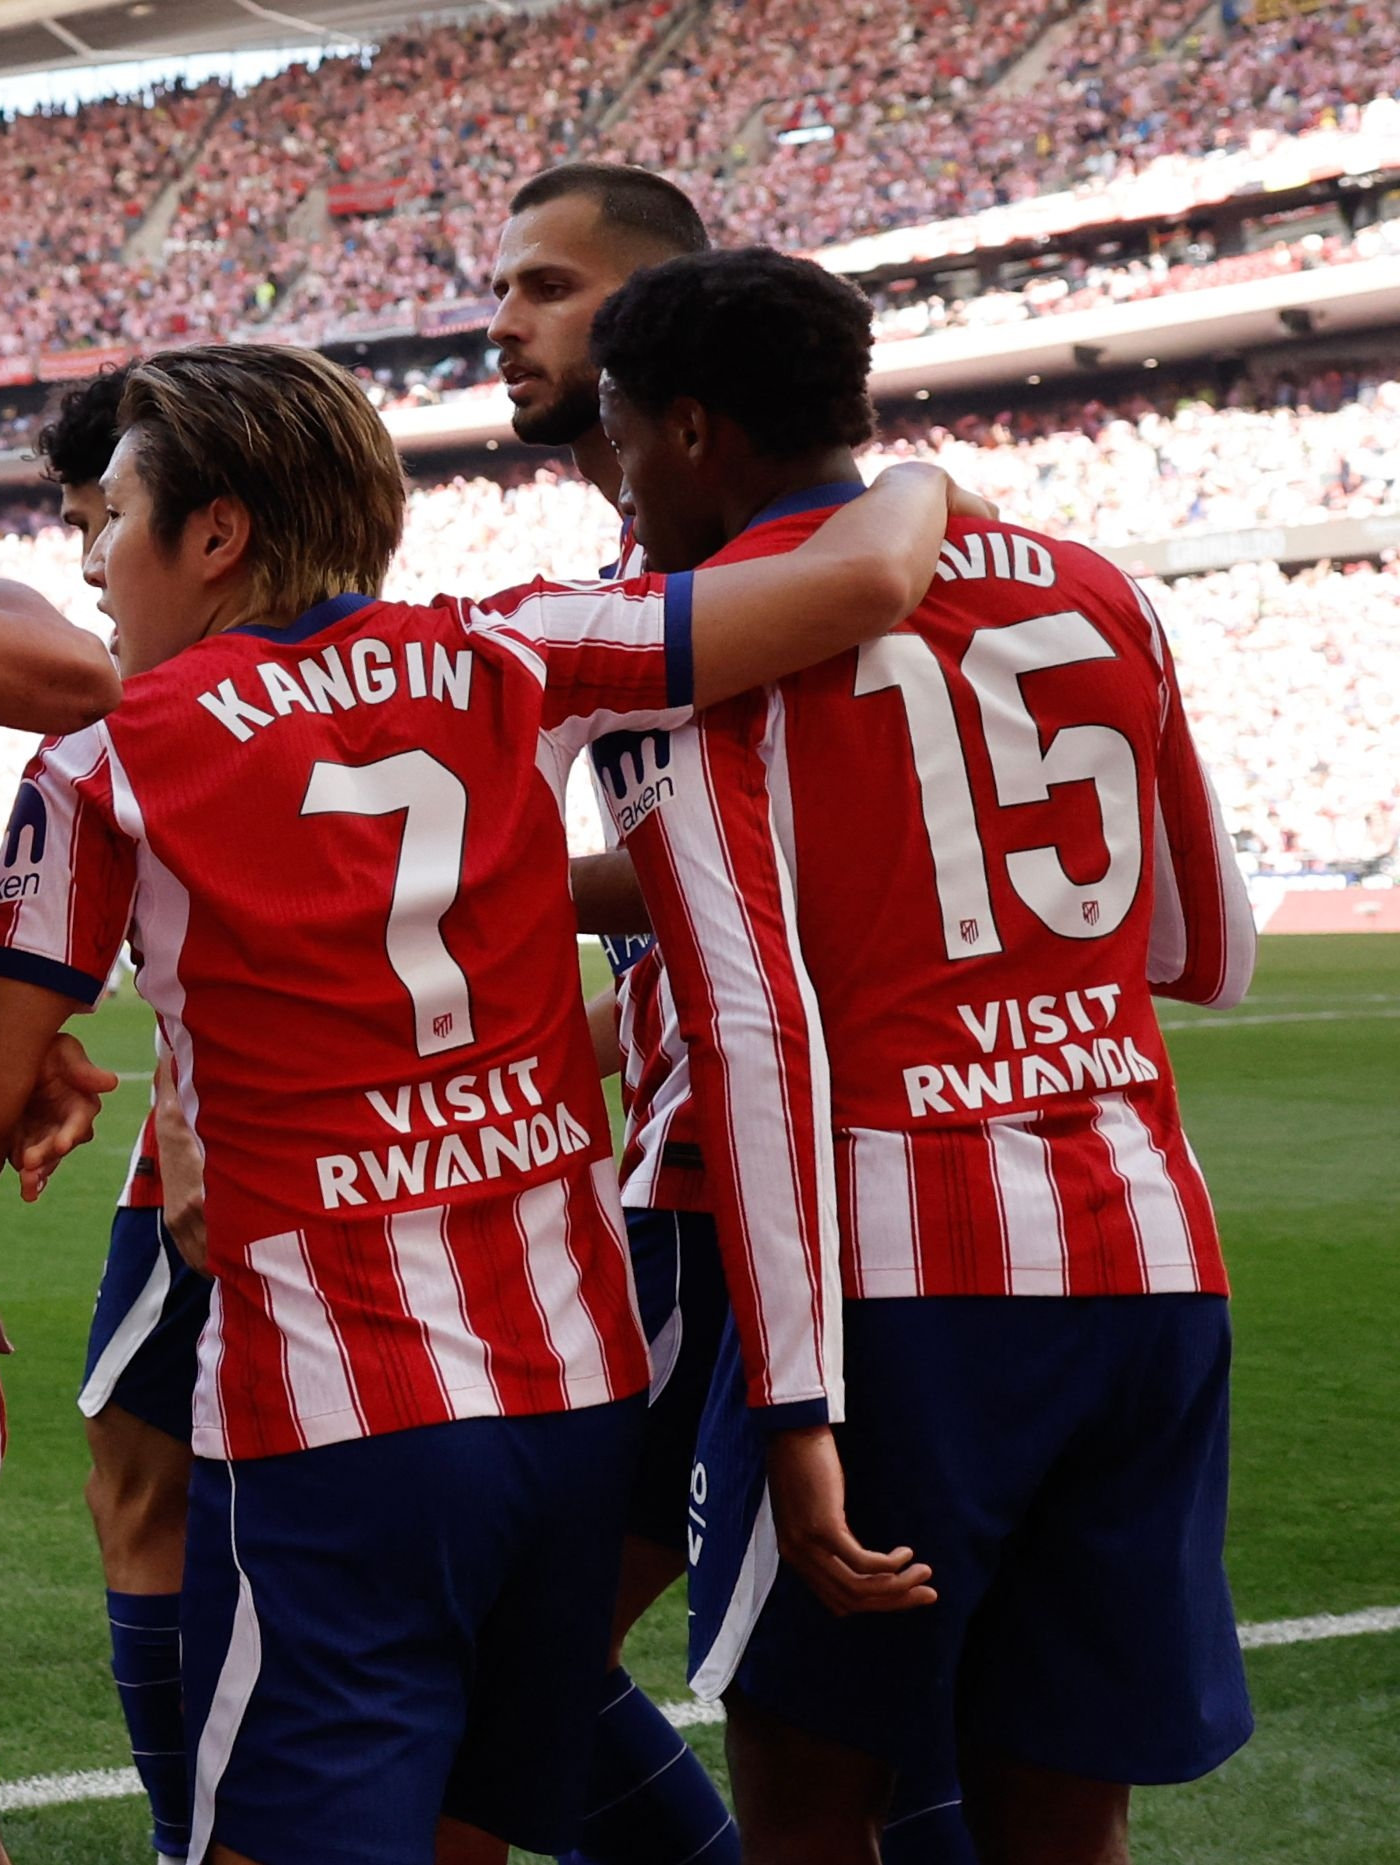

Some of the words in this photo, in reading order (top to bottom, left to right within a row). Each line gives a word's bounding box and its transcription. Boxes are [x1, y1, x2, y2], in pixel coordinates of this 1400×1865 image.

[936, 532, 1056, 588] VID
[197, 638, 473, 743] KANGIN
[617, 776, 674, 832] aken
[853, 610, 1142, 961] 15
[300, 748, 476, 1058] 7
[956, 983, 1122, 1054] VISIT
[365, 1056, 543, 1134] VISIT
[902, 1036, 1159, 1118] RWANDA
[315, 1101, 591, 1210] RWANDA
